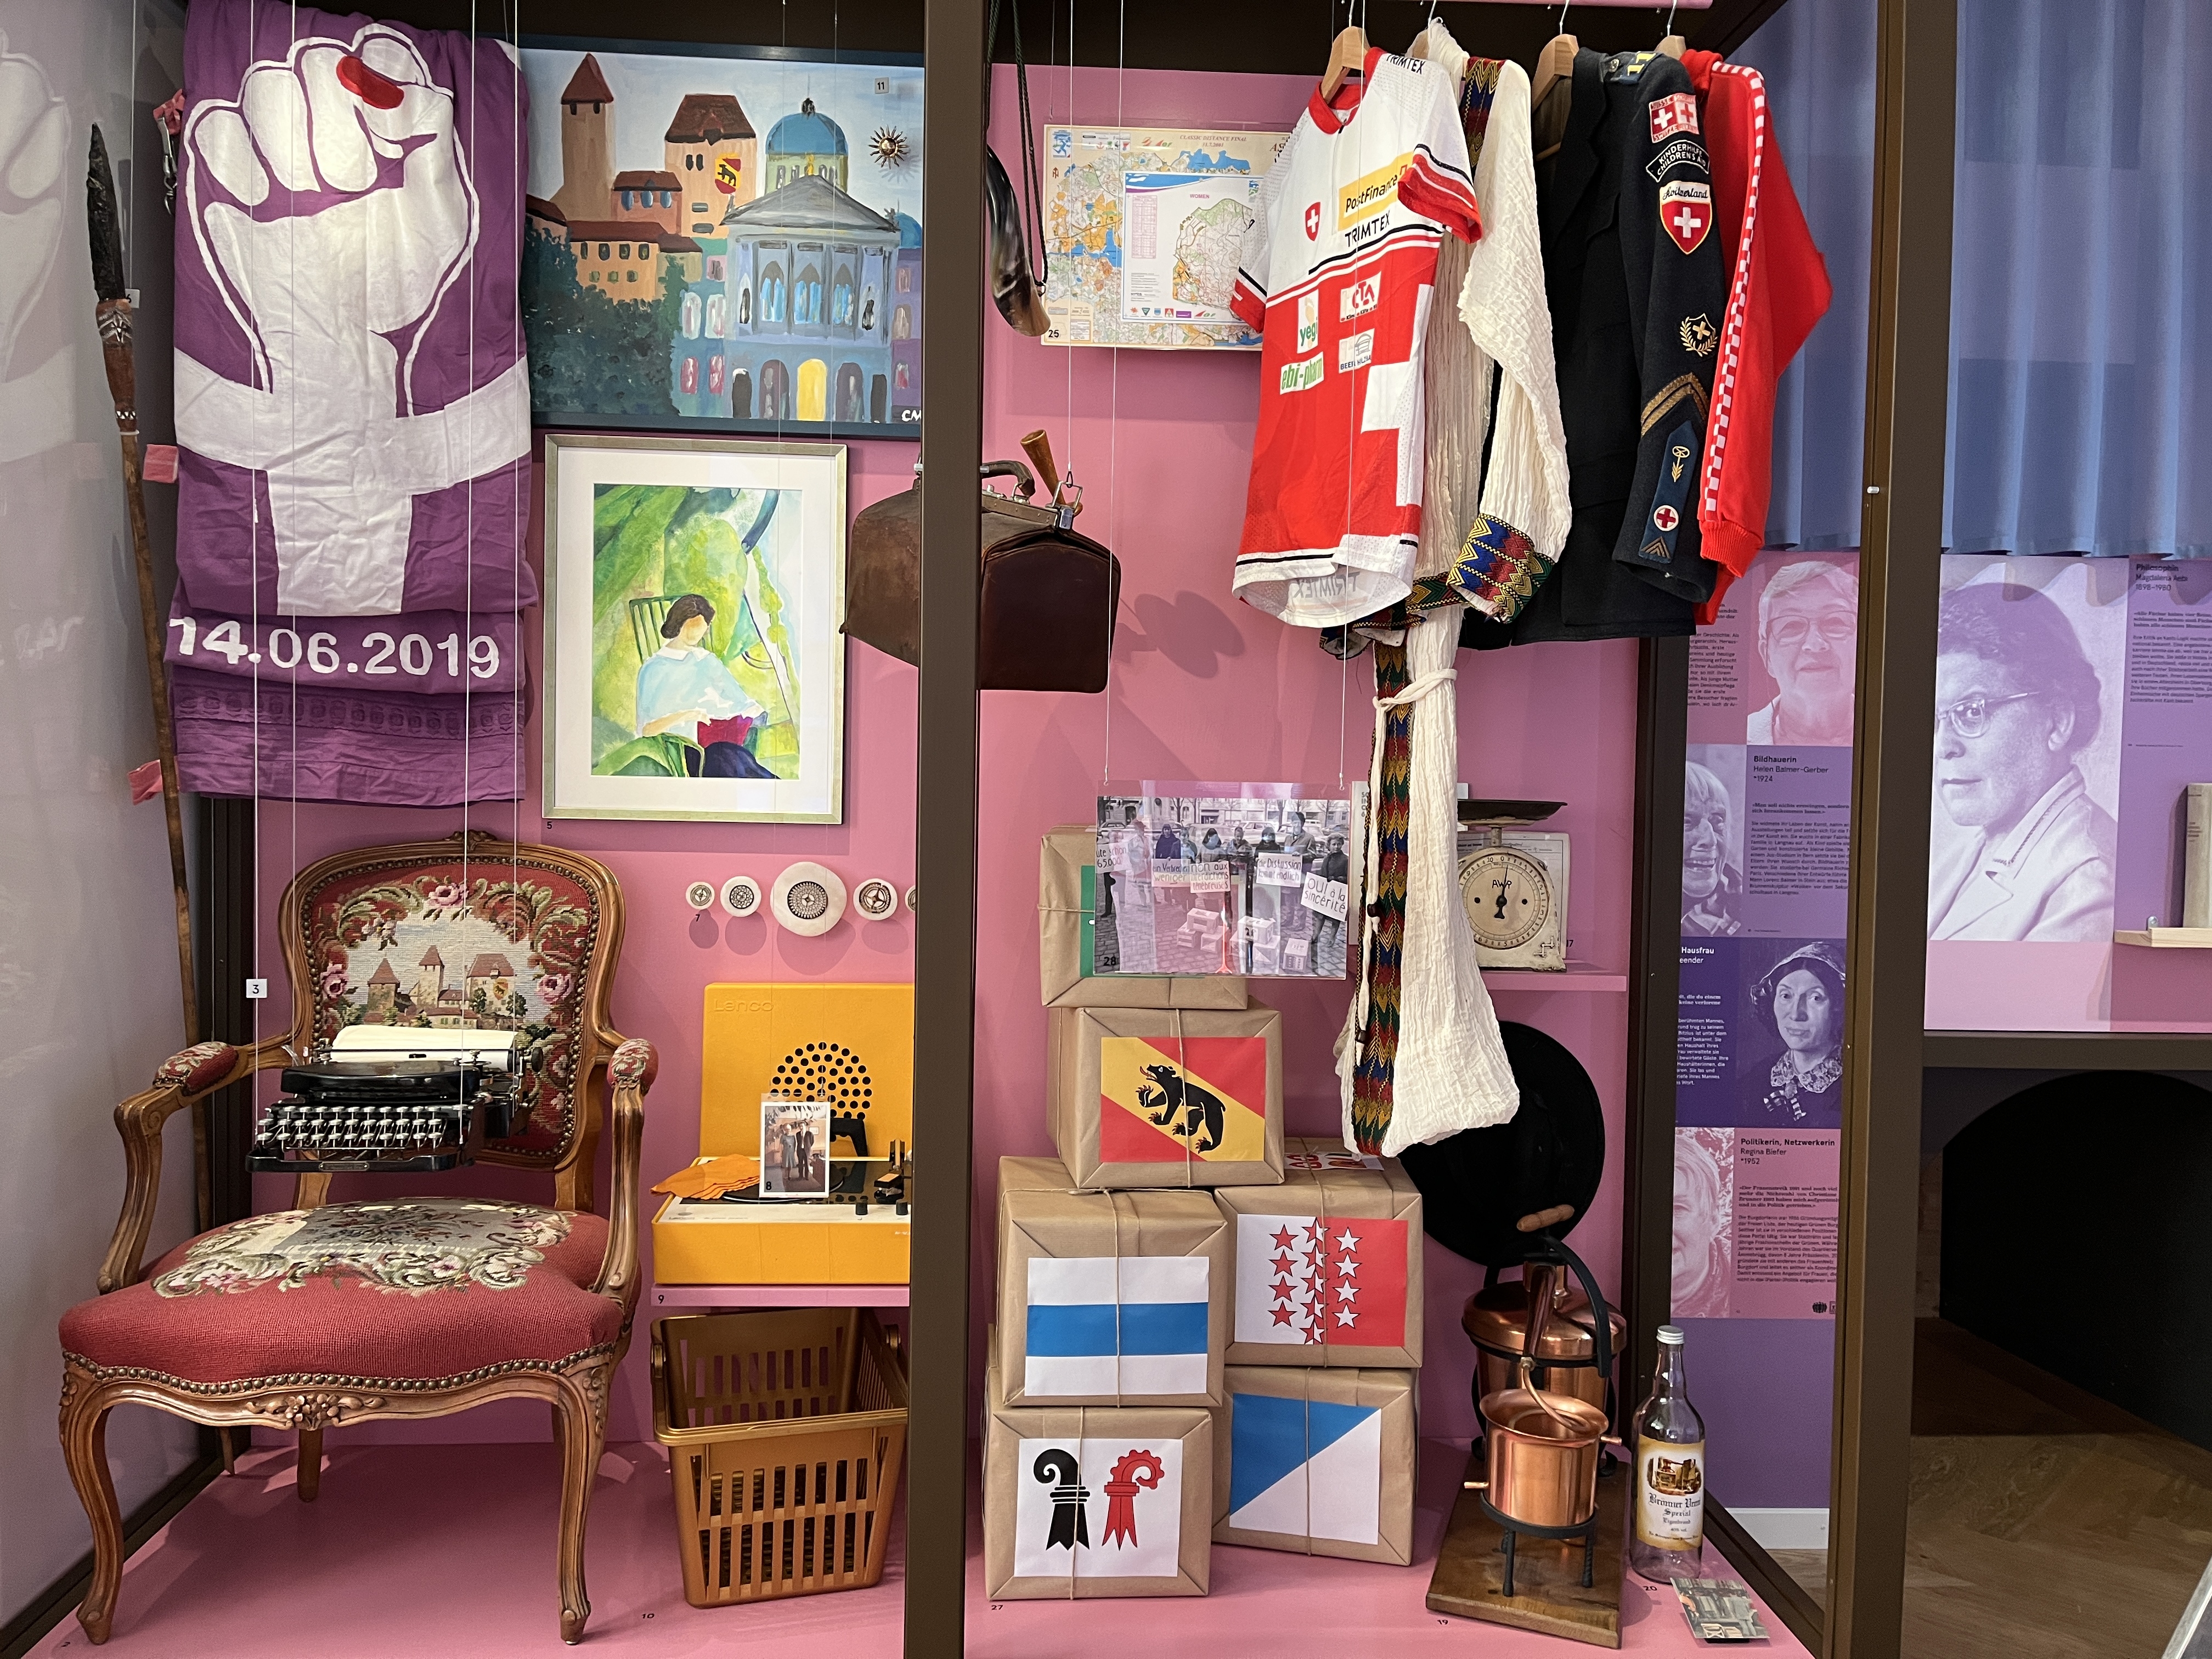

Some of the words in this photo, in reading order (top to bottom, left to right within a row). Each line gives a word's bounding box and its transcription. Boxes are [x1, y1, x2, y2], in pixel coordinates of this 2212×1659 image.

[1386, 54, 1426, 75] TRIMTEX
[877, 81, 884, 90] 11
[1658, 144, 1702, 165] KINDERHILFE
[1657, 152, 1696, 176] CHILDREN'S
[1346, 174, 1398, 213] PostFinance
[1345, 210, 1390, 247] TRIMTEX
[1048, 329, 1059, 338] 25
[1300, 316, 1318, 347] yegi
[1281, 357, 1322, 391] ebi-pharm
[168, 616, 500, 679] 14.06.2019
[546, 821, 552, 830] 5
[1191, 863, 1210, 872] non
[1267, 858, 1301, 871] Diskussion
[1154, 874, 1187, 884] weniger
[1277, 871, 1300, 881] endlich
[1338, 888, 1346, 901] la
[1104, 956, 1116, 966] 28
[252, 984, 259, 994] 3
[713, 999, 774, 1012] Lenco
[1740, 1148, 1764, 1156] Regina
[766, 1181, 772, 1190] 8
[658, 1295, 664, 1305] 9
